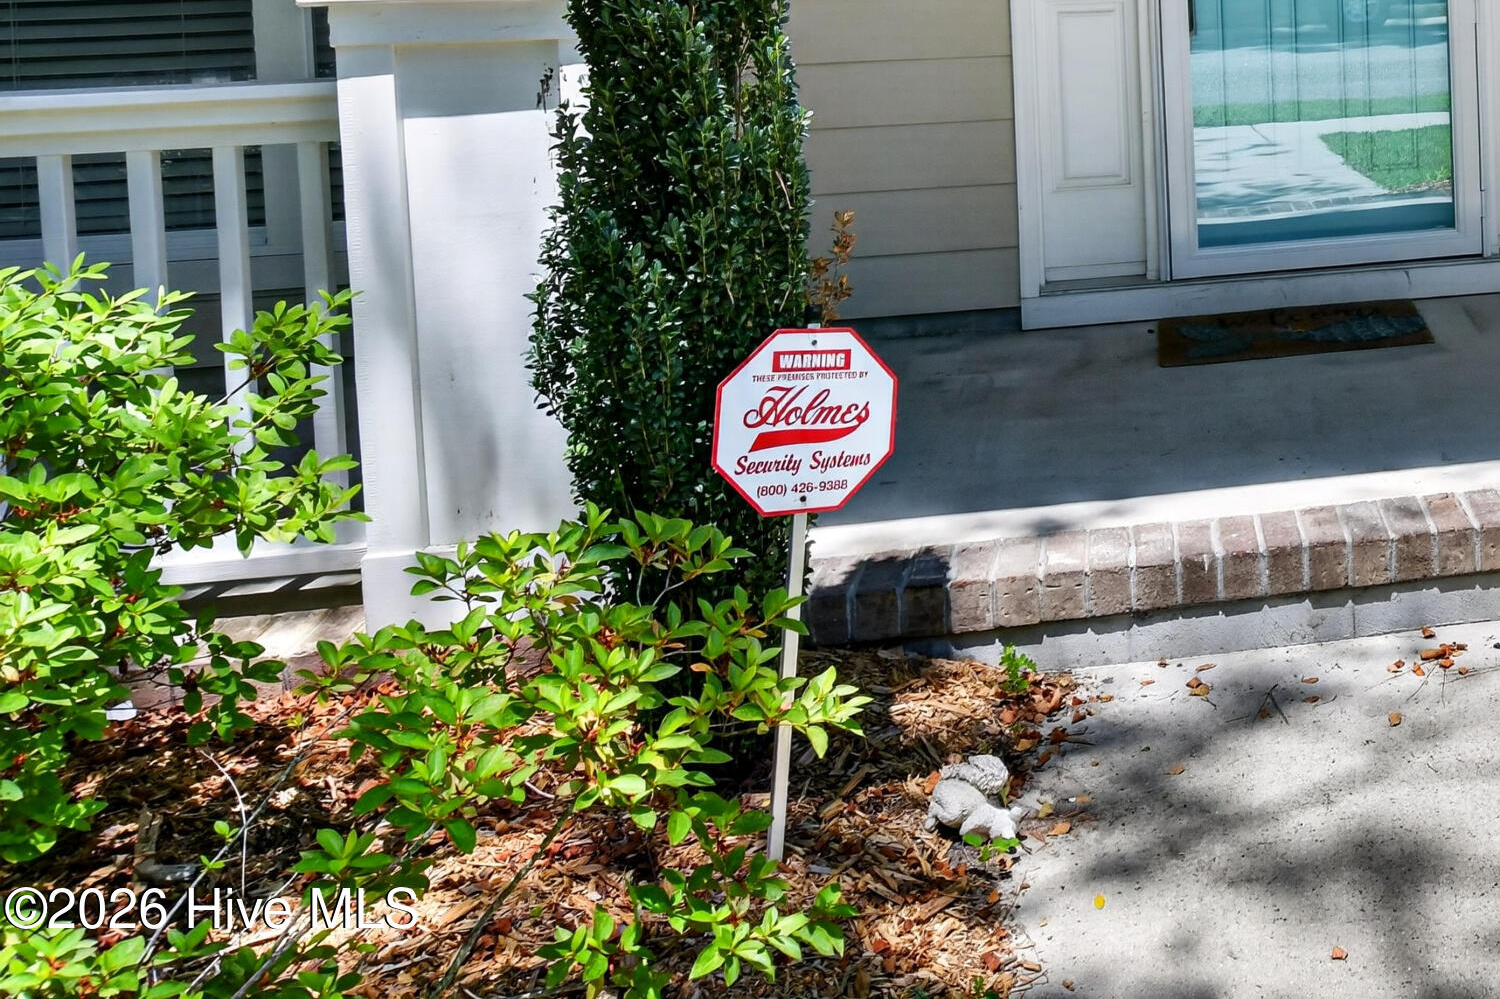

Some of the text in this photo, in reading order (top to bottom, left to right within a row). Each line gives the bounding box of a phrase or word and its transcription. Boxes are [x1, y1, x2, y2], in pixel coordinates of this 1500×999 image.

[779, 353, 845, 369] WARNING
[752, 370, 868, 383] THESE PREMISES PROTECTED BY
[743, 384, 870, 428] Holmes
[734, 450, 871, 476] Security Systems
[756, 479, 848, 498] (800) 426-9388
